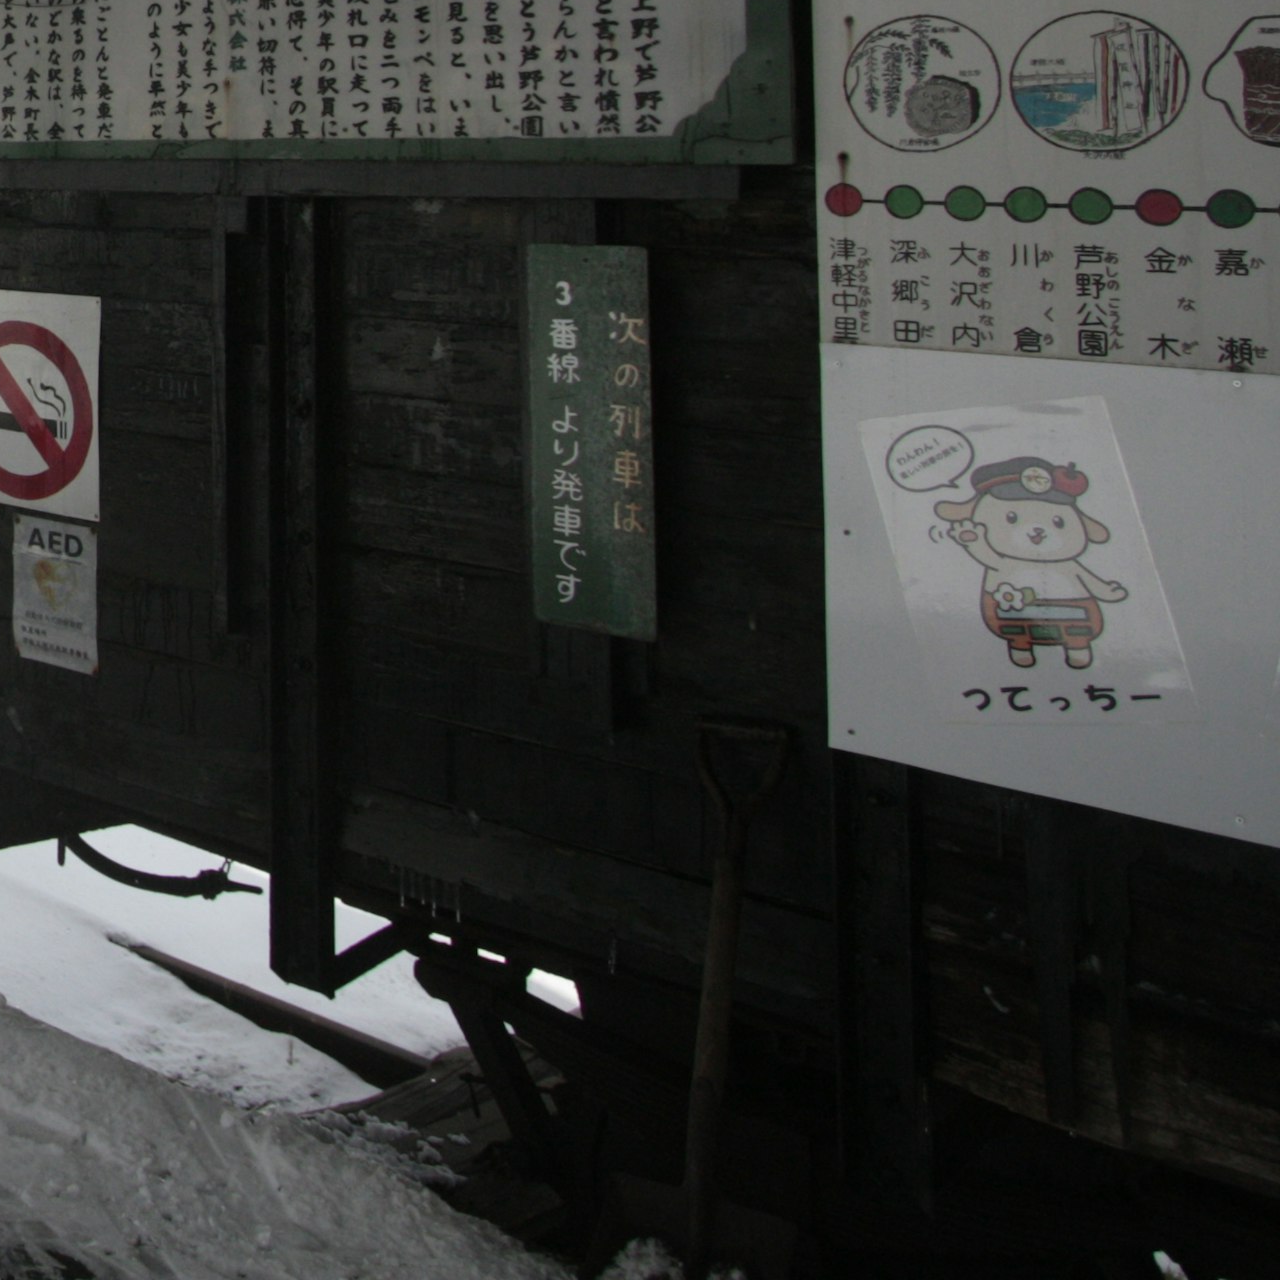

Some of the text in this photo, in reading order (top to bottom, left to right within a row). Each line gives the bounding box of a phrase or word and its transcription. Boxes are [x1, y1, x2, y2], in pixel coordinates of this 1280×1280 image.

[830, 237, 859, 344] 津軽中里
[890, 239, 920, 343] 深郷田
[949, 241, 981, 348] 大沢内
[1010, 243, 1042, 353] 川倉
[1040, 251, 1054, 346] かわくら
[1073, 245, 1109, 357] 芦野公園
[1104, 251, 1124, 351] あしのこうえん
[1145, 247, 1182, 360] 金木
[1177, 255, 1199, 355] かなぎ
[1214, 248, 1254, 368] 嘉瀬
[1250, 257, 1268, 359] かせ
[608, 310, 646, 533] 次の列車は
[28, 527, 84, 559] AED
[962, 683, 1162, 712] つてっちー
